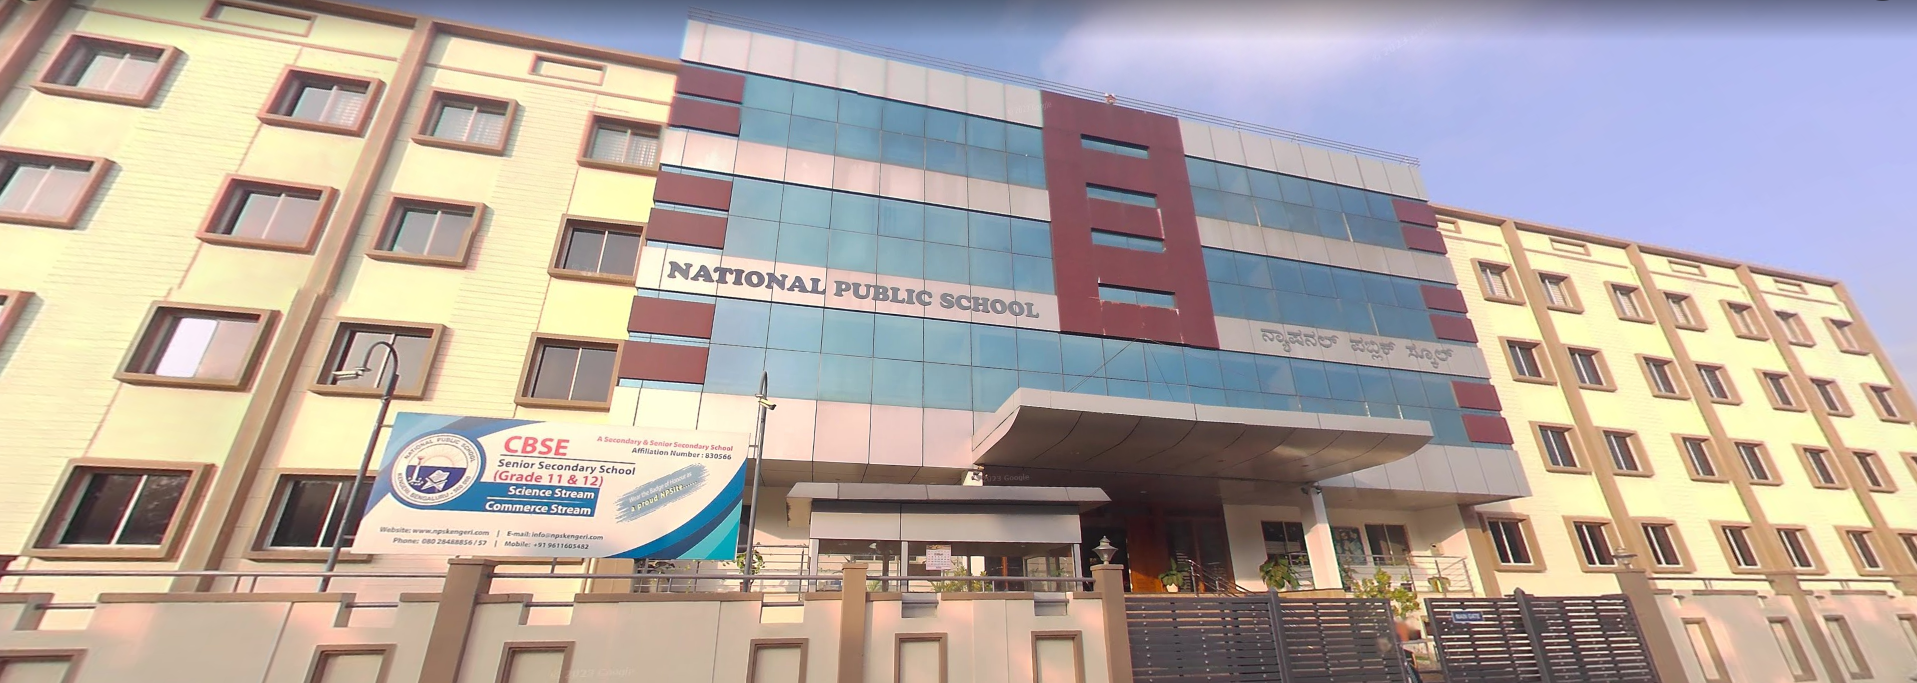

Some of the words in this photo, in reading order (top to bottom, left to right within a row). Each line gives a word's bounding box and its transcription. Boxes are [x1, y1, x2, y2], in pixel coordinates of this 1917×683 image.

[667, 260, 826, 295] NATIONAL
[834, 280, 933, 306] PUBLIC
[939, 292, 1040, 318] SCHOOL
[1260, 327, 1339, 352] ನ್ಯಾಷನಲ್
[1350, 338, 1396, 361] ಪಬ್ಲಿಕ್
[1405, 344, 1454, 369] ಸ್ಕೂಲ್
[404, 440, 433, 459] NATIONAL
[460, 443, 476, 462] SCHOOL
[504, 435, 570, 456] CBSE
[604, 436, 641, 446] Secondary
[650, 439, 673, 447] Senior
[673, 441, 710, 451] Secondary
[710, 444, 733, 452] School
[631, 447, 669, 456] Affiliation
[670, 450, 700, 458] Number
[705, 452, 732, 460] 830566
[497, 459, 536, 469] Senior
[537, 461, 597, 475] Secondary
[598, 465, 636, 476] School
[493, 470, 543, 483] (Grade
[548, 474, 562, 484] 11
[567, 475, 579, 485] &
[583, 475, 604, 488] 12)
[508, 486, 552, 496] Science
[553, 488, 595, 499] Stream
[641, 489, 650, 497] the
[485, 501, 548, 513] Commerce
[550, 504, 592, 515] Stream
[637, 495, 659, 510] proud
[412, 528, 490, 536] www.npskengeri.com
[531, 531, 604, 541] info@npskengeri.com
[547, 542, 590, 550] 9611605482
